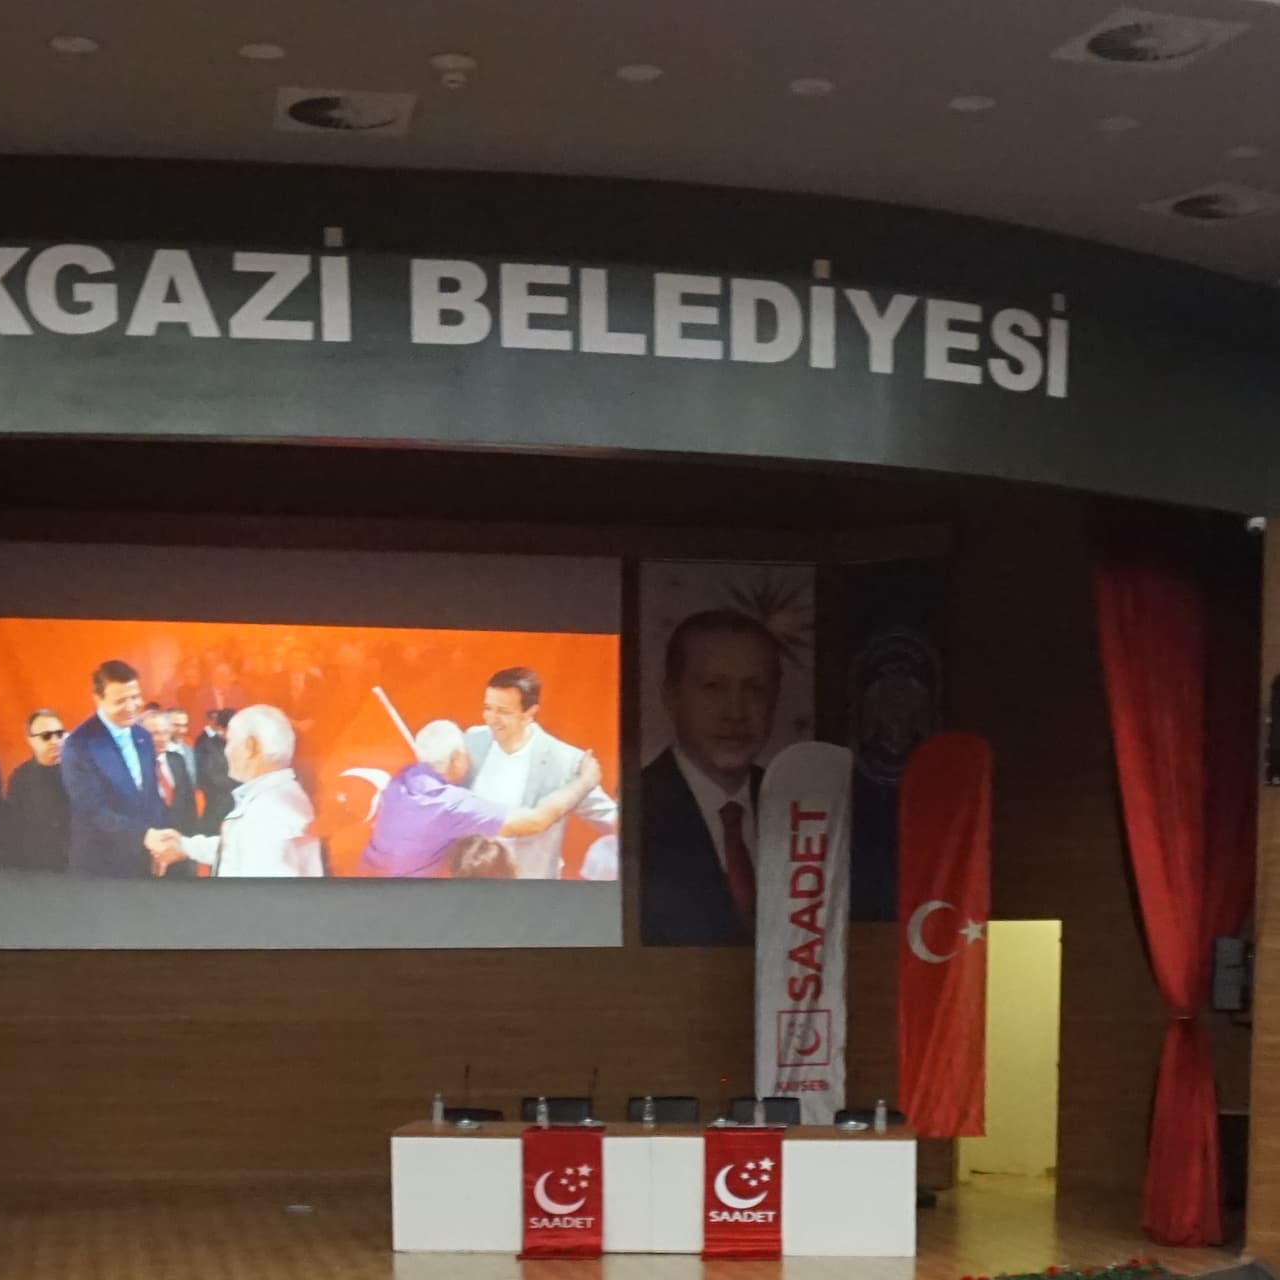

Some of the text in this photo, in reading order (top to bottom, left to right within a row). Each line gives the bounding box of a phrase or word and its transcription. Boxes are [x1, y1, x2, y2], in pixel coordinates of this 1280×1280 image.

[410, 258, 1070, 398] BELEDİYESİ
[787, 800, 828, 1001] SAADET
[529, 1216, 595, 1229] SAADET
[709, 1210, 776, 1223] SAADET
